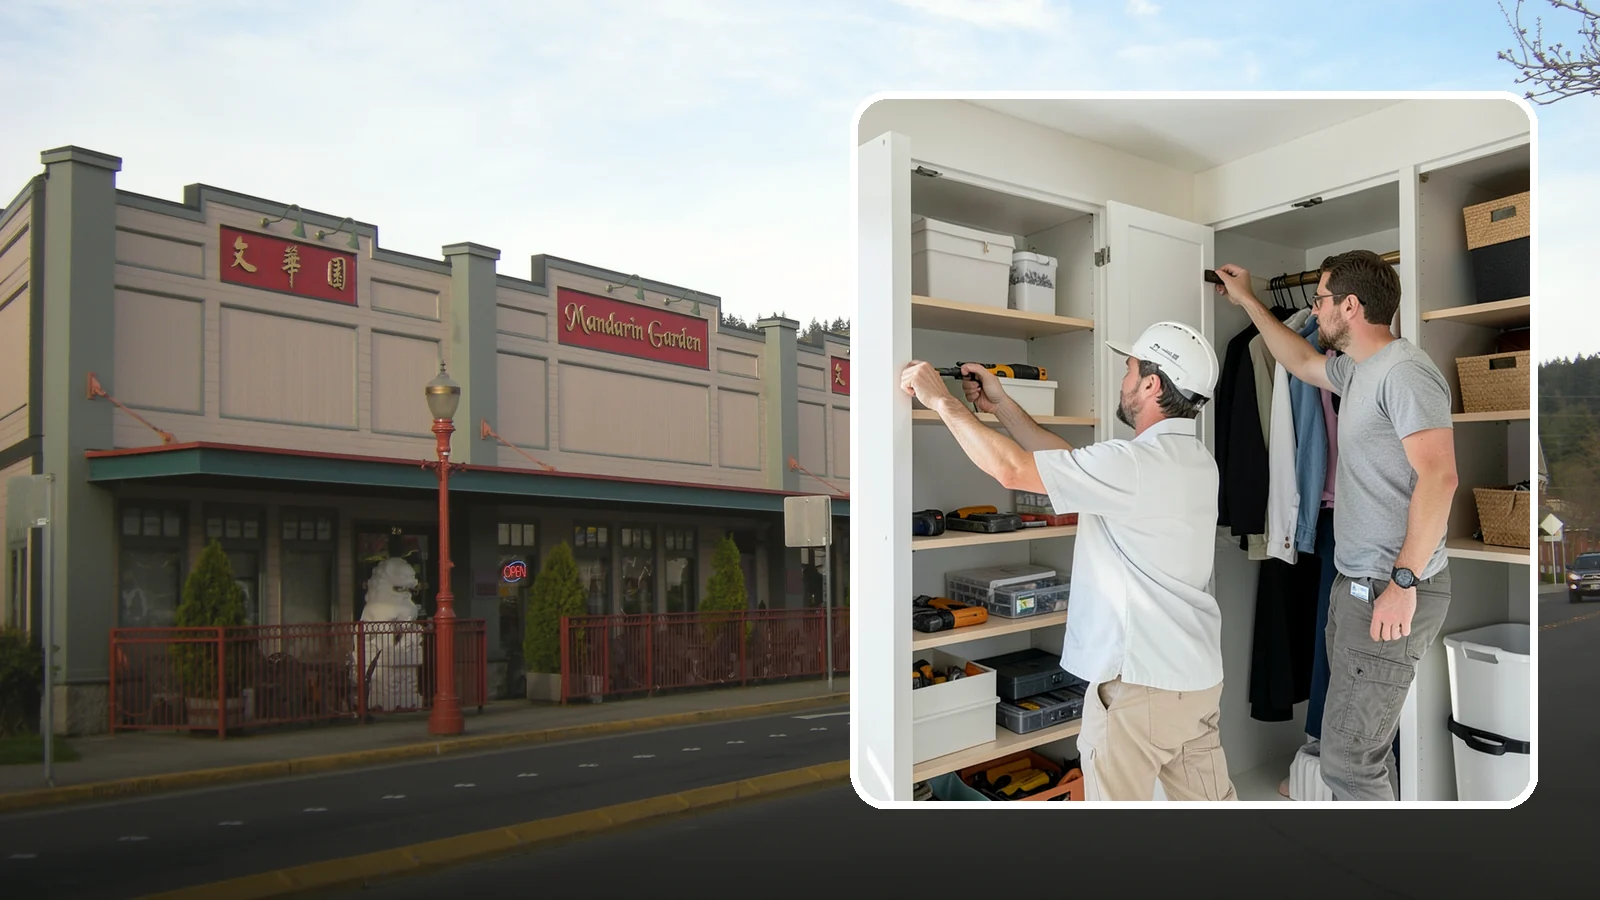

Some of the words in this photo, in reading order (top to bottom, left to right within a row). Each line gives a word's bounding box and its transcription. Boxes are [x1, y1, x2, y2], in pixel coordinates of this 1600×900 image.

[231, 236, 346, 290] 文華園
[564, 302, 644, 341] Mandarin
[647, 320, 702, 352] Garden
[503, 565, 527, 578] OPEN
